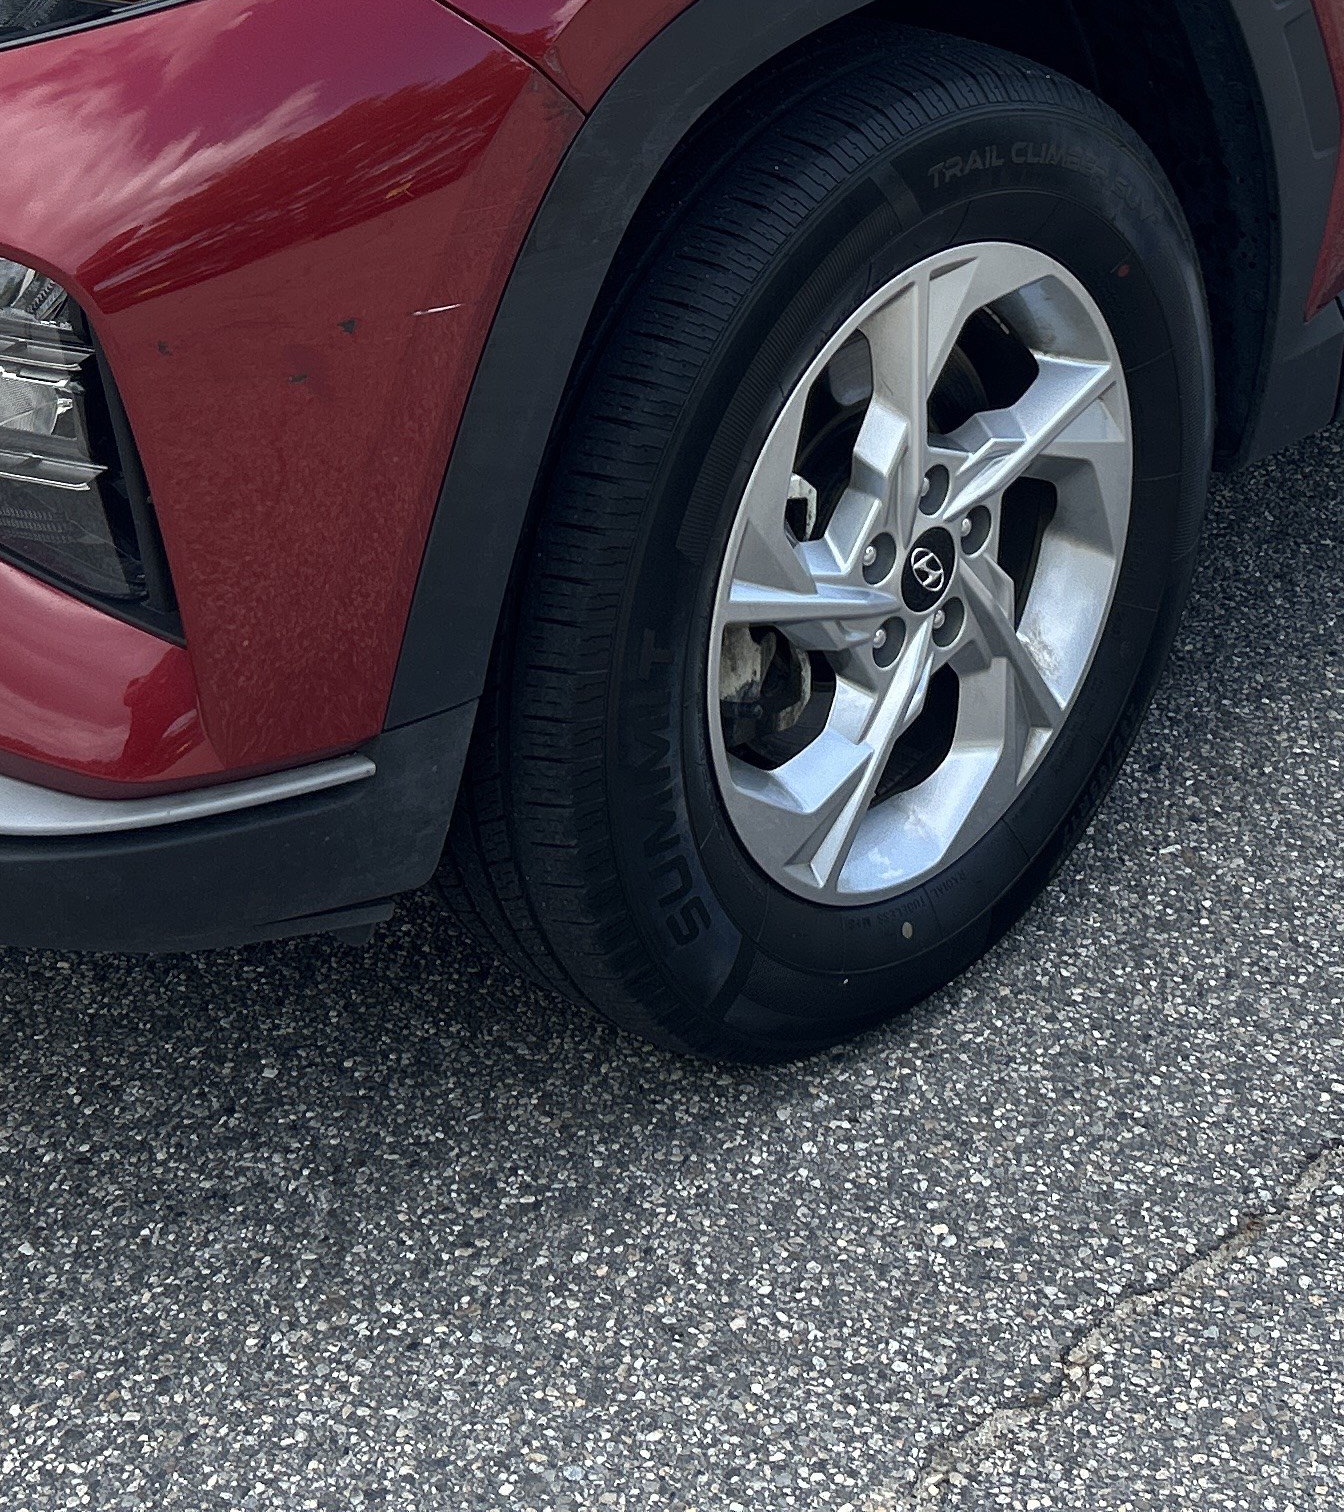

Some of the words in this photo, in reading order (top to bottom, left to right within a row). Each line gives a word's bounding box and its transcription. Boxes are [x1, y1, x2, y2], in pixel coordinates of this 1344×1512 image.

[927, 144, 1004, 188] TRAIL
[1011, 141, 1109, 185] CLIMBER
[632, 628, 712, 947] SUMMIT
